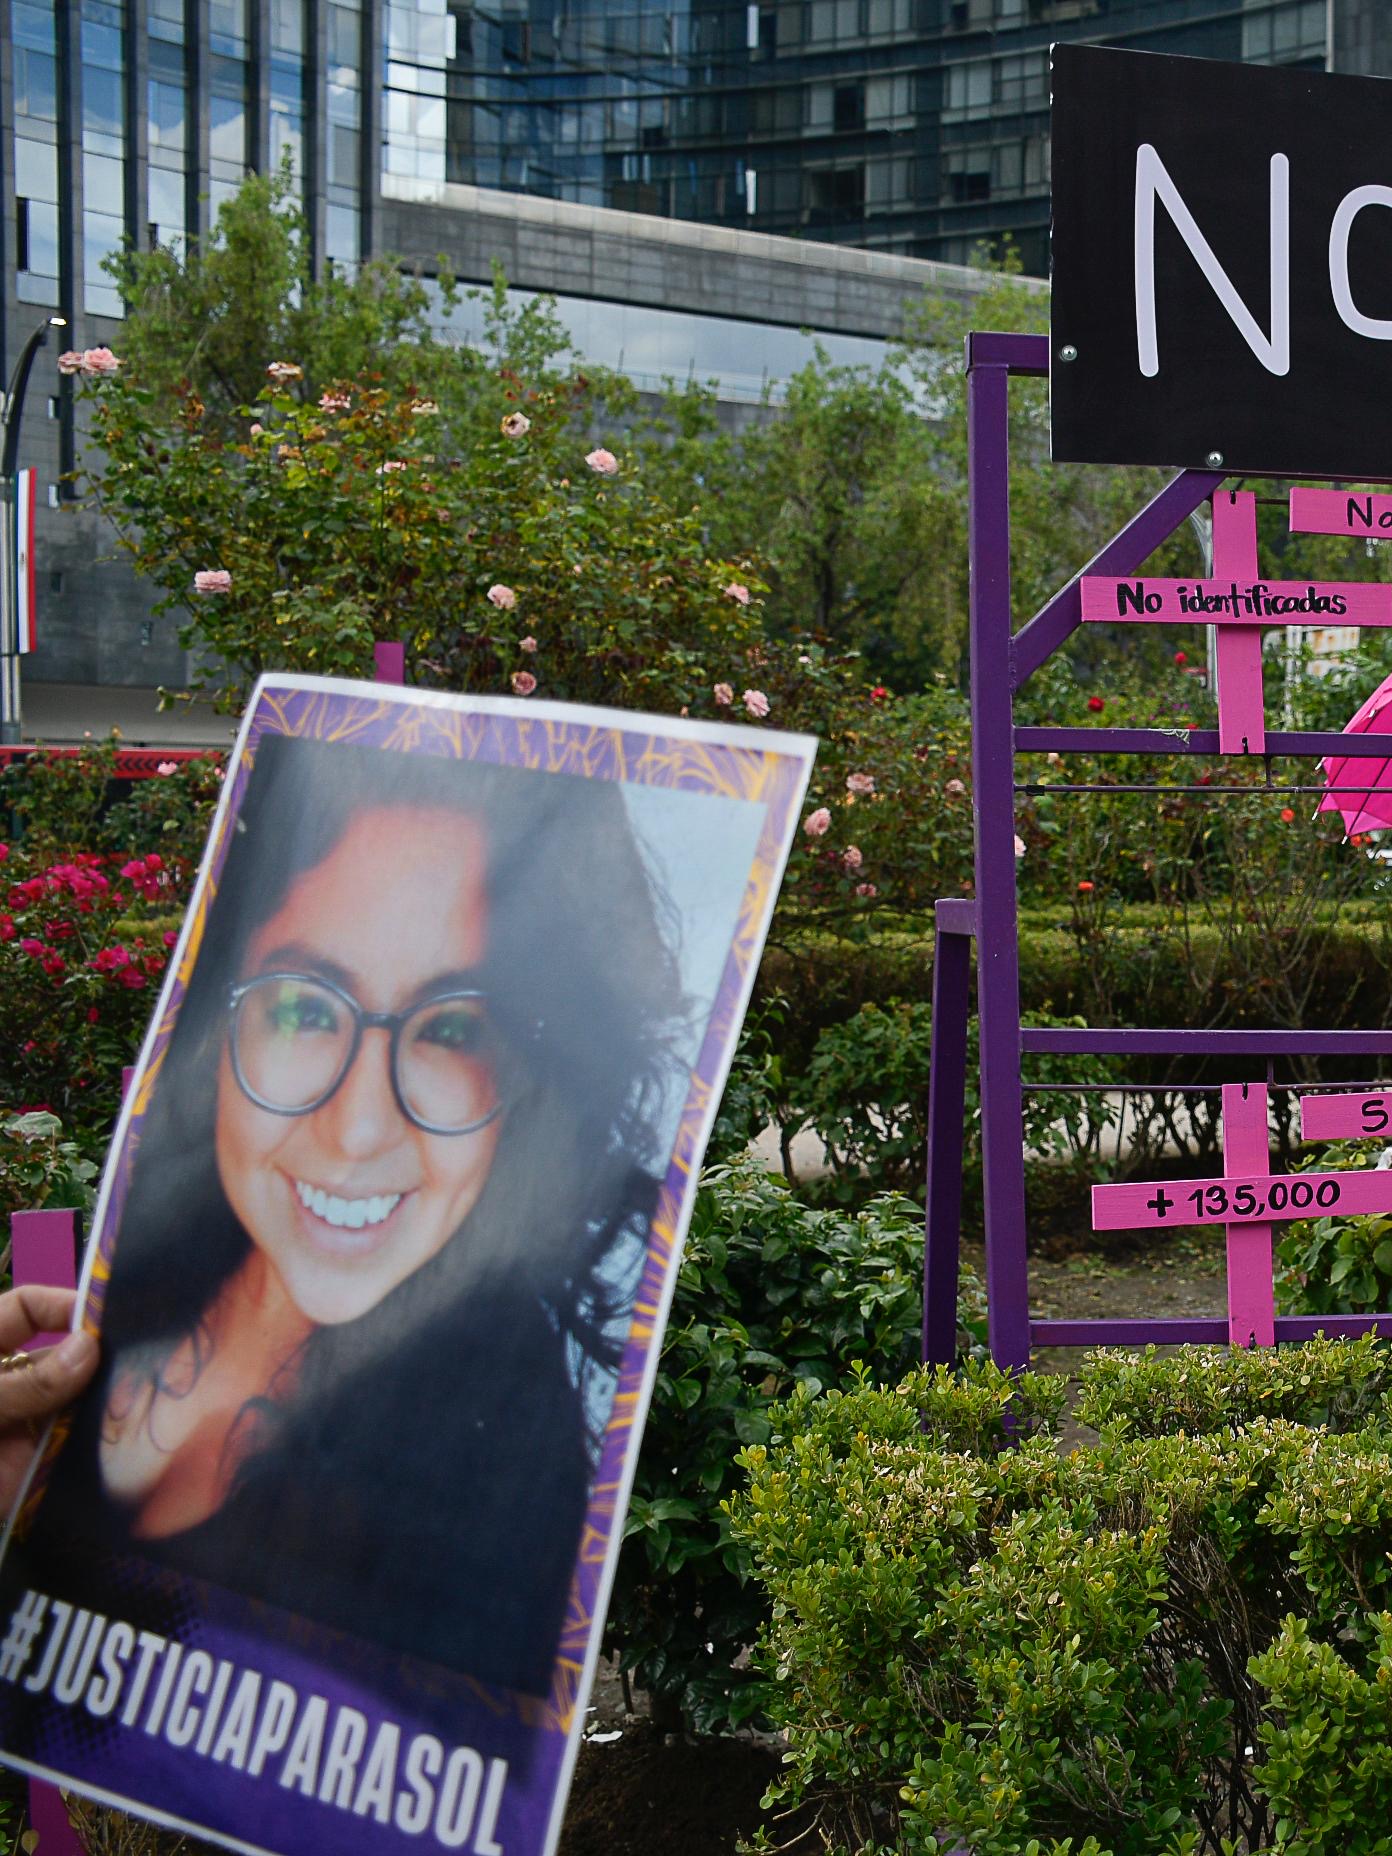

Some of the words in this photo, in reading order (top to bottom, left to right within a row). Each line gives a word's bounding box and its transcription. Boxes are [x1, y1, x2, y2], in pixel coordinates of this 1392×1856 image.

[1116, 582, 1164, 617] No
[1176, 582, 1348, 619] identificadas
[1147, 1188, 1174, 1218] +
[1187, 1179, 1342, 1218] 135,000
[0, 1589, 508, 1856] #JUSTICIAPARASOL
